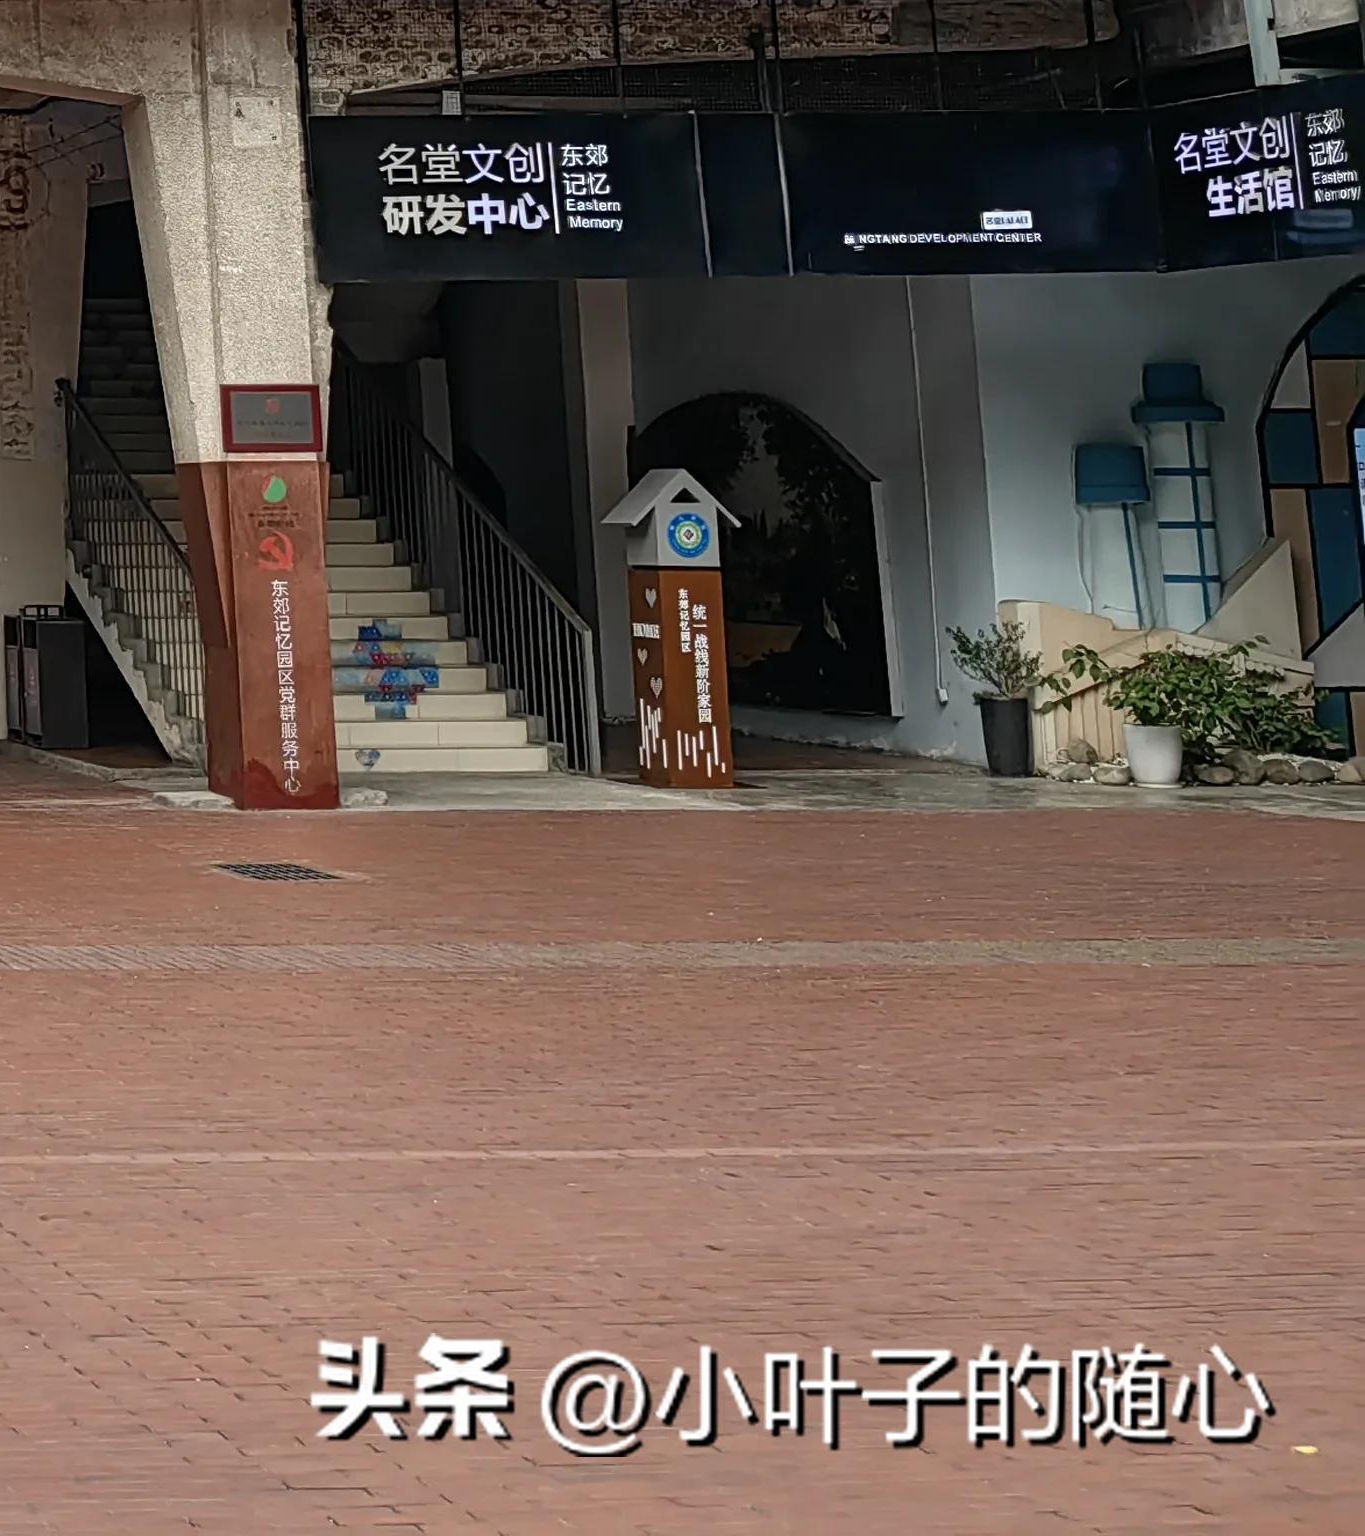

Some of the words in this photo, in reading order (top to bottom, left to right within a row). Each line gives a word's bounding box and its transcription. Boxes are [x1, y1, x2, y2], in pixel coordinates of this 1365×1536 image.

[1305, 108, 1345, 136] 东郊
[561, 143, 608, 167] 东郊
[1173, 115, 1290, 174] 名堂文创
[1308, 139, 1349, 167] 记忆
[378, 142, 545, 185] 名堂文创
[563, 172, 611, 196] 记忆
[1313, 169, 1358, 185] Eastern
[1206, 166, 1295, 217] 生活馆
[1314, 186, 1361, 203] Memory
[381, 192, 550, 235] 研发中心
[566, 199, 621, 212] Eastern
[569, 217, 624, 232] Memory
[910, 233, 994, 244] DEVELOPMENT
[995, 232, 1043, 243] CENTER
[270, 579, 301, 794] 东郊记忆园区党群服务中心
